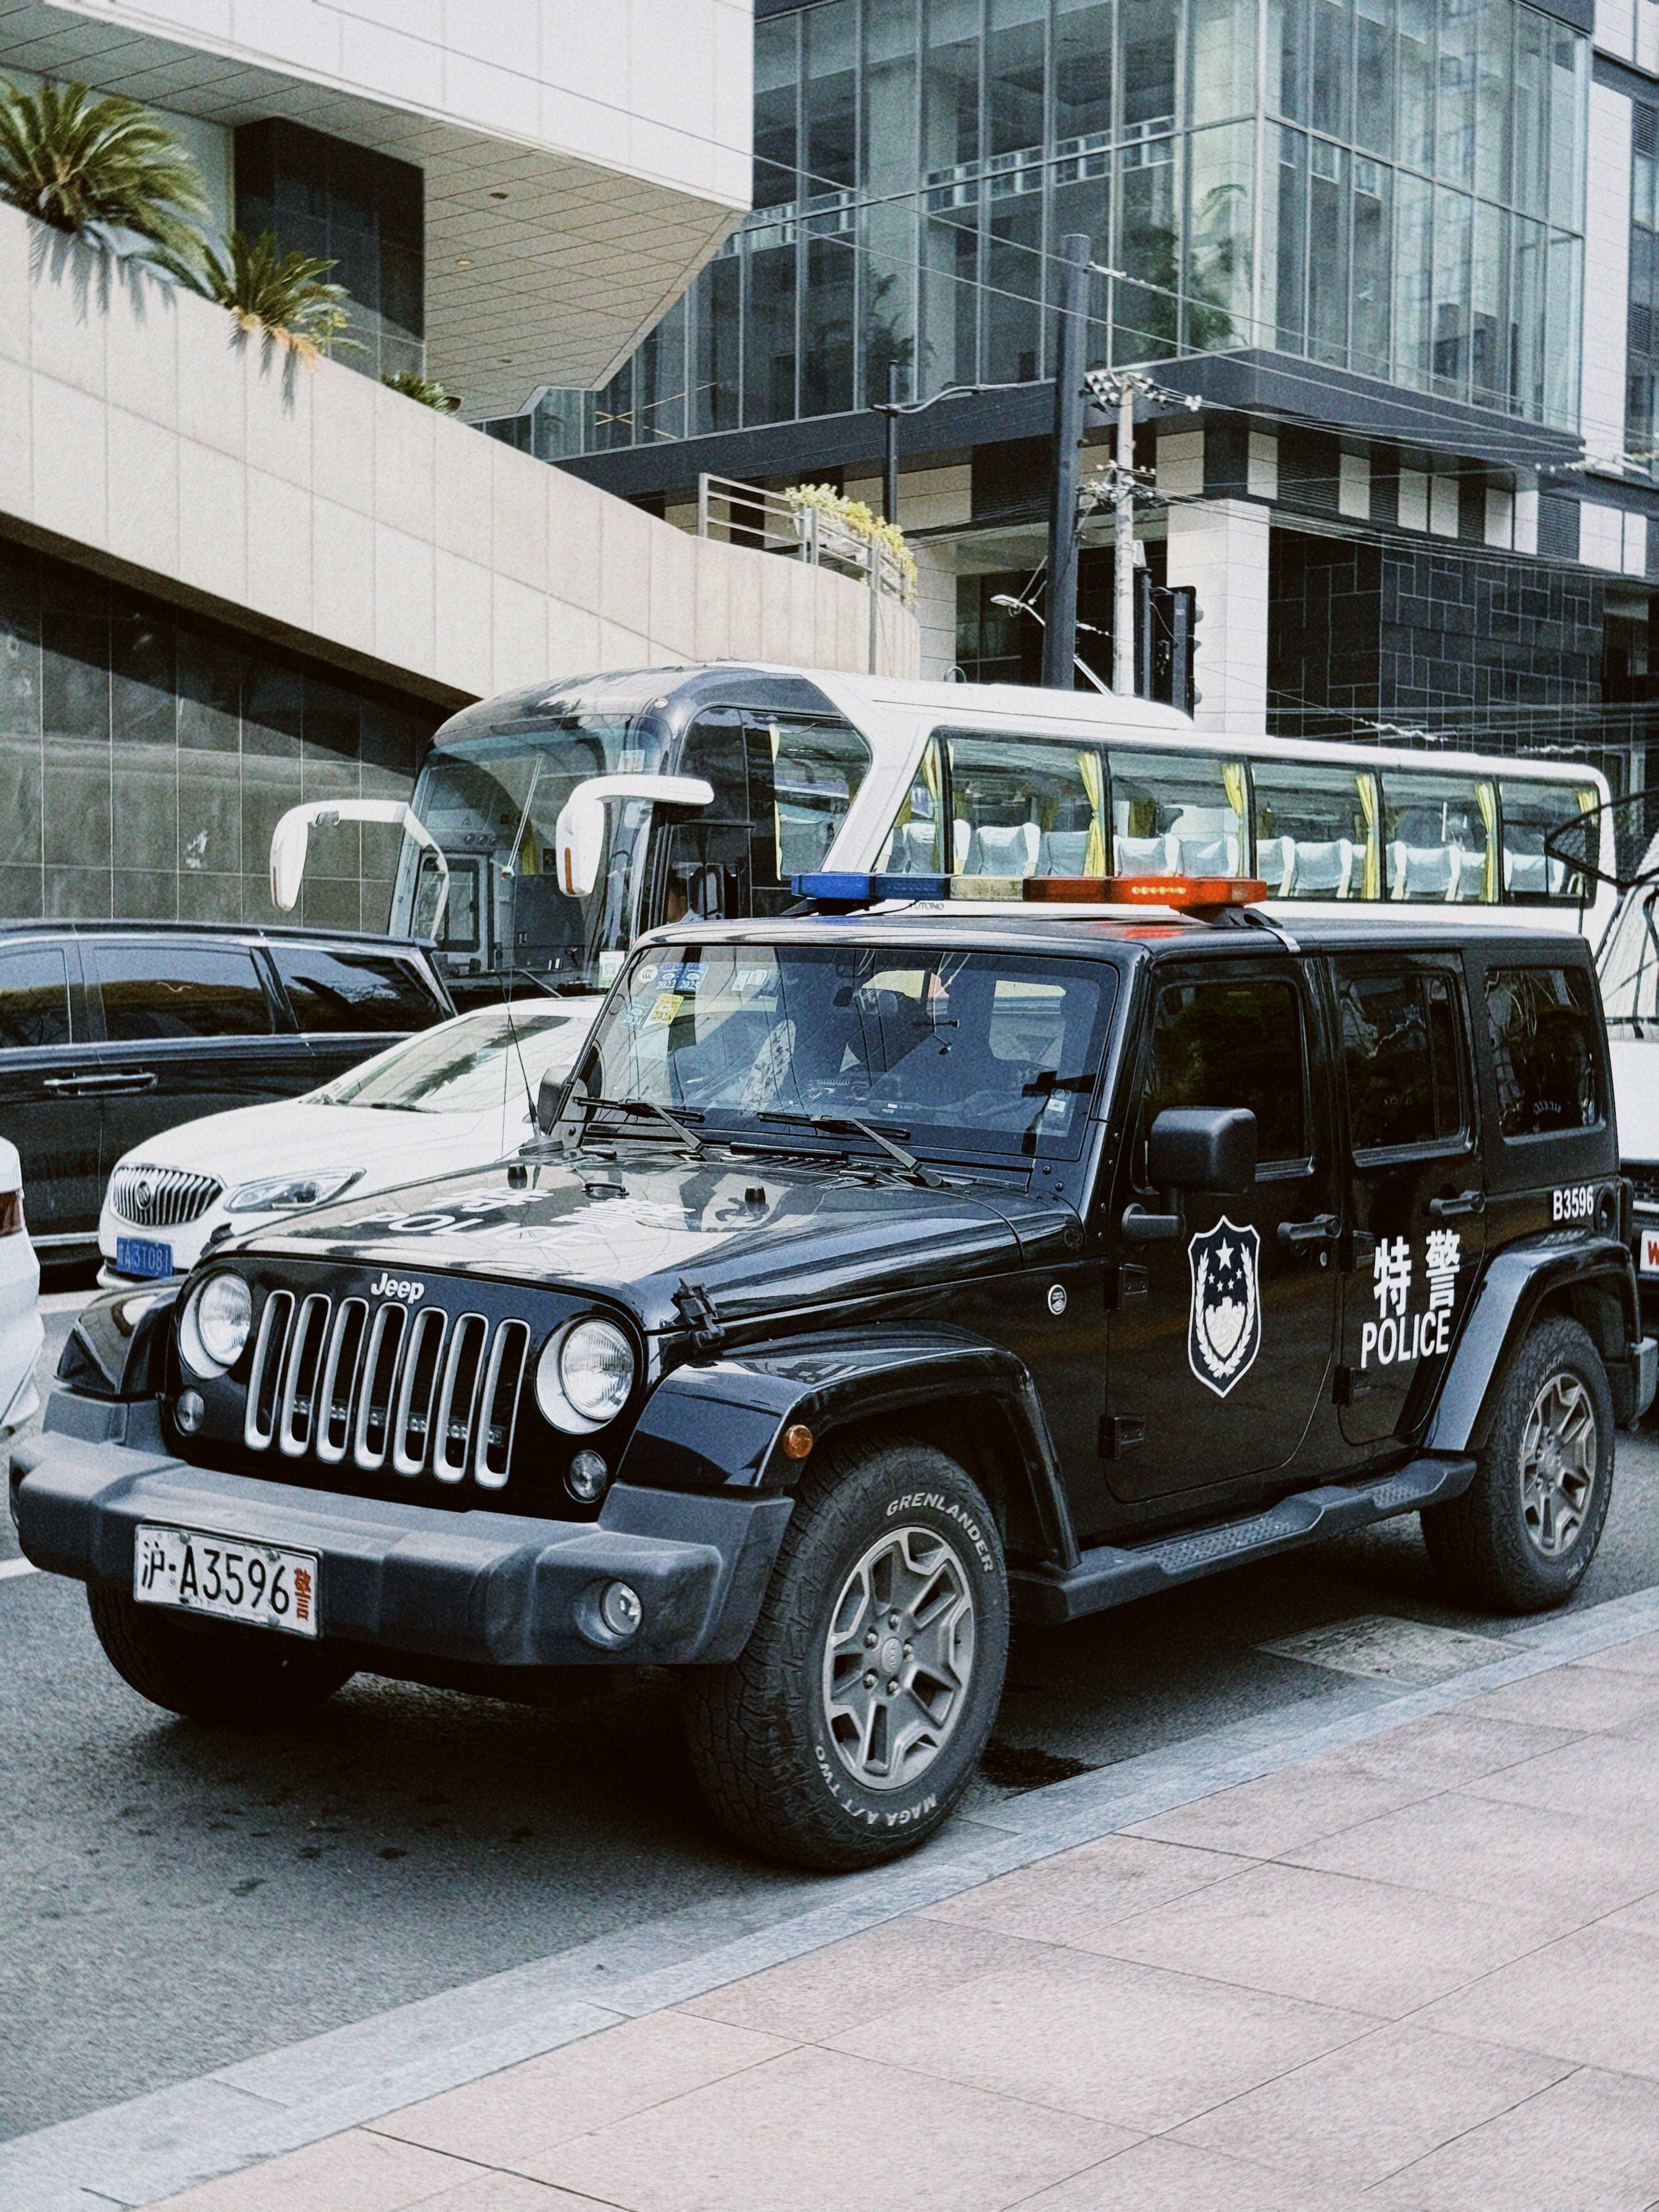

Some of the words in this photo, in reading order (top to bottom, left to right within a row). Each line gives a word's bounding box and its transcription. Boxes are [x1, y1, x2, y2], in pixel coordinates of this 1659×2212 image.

[1552, 1184, 1594, 1222] B3596
[341, 1210, 609, 1252] POLICE
[370, 1272, 425, 1305] Jeep
[1373, 1228, 1462, 1319] 特警
[1360, 1307, 1452, 1370] POLICE
[885, 1492, 994, 1573] GRENLANDER
[814, 1745, 841, 1798] TWO
[886, 1792, 938, 1827] MAGA
